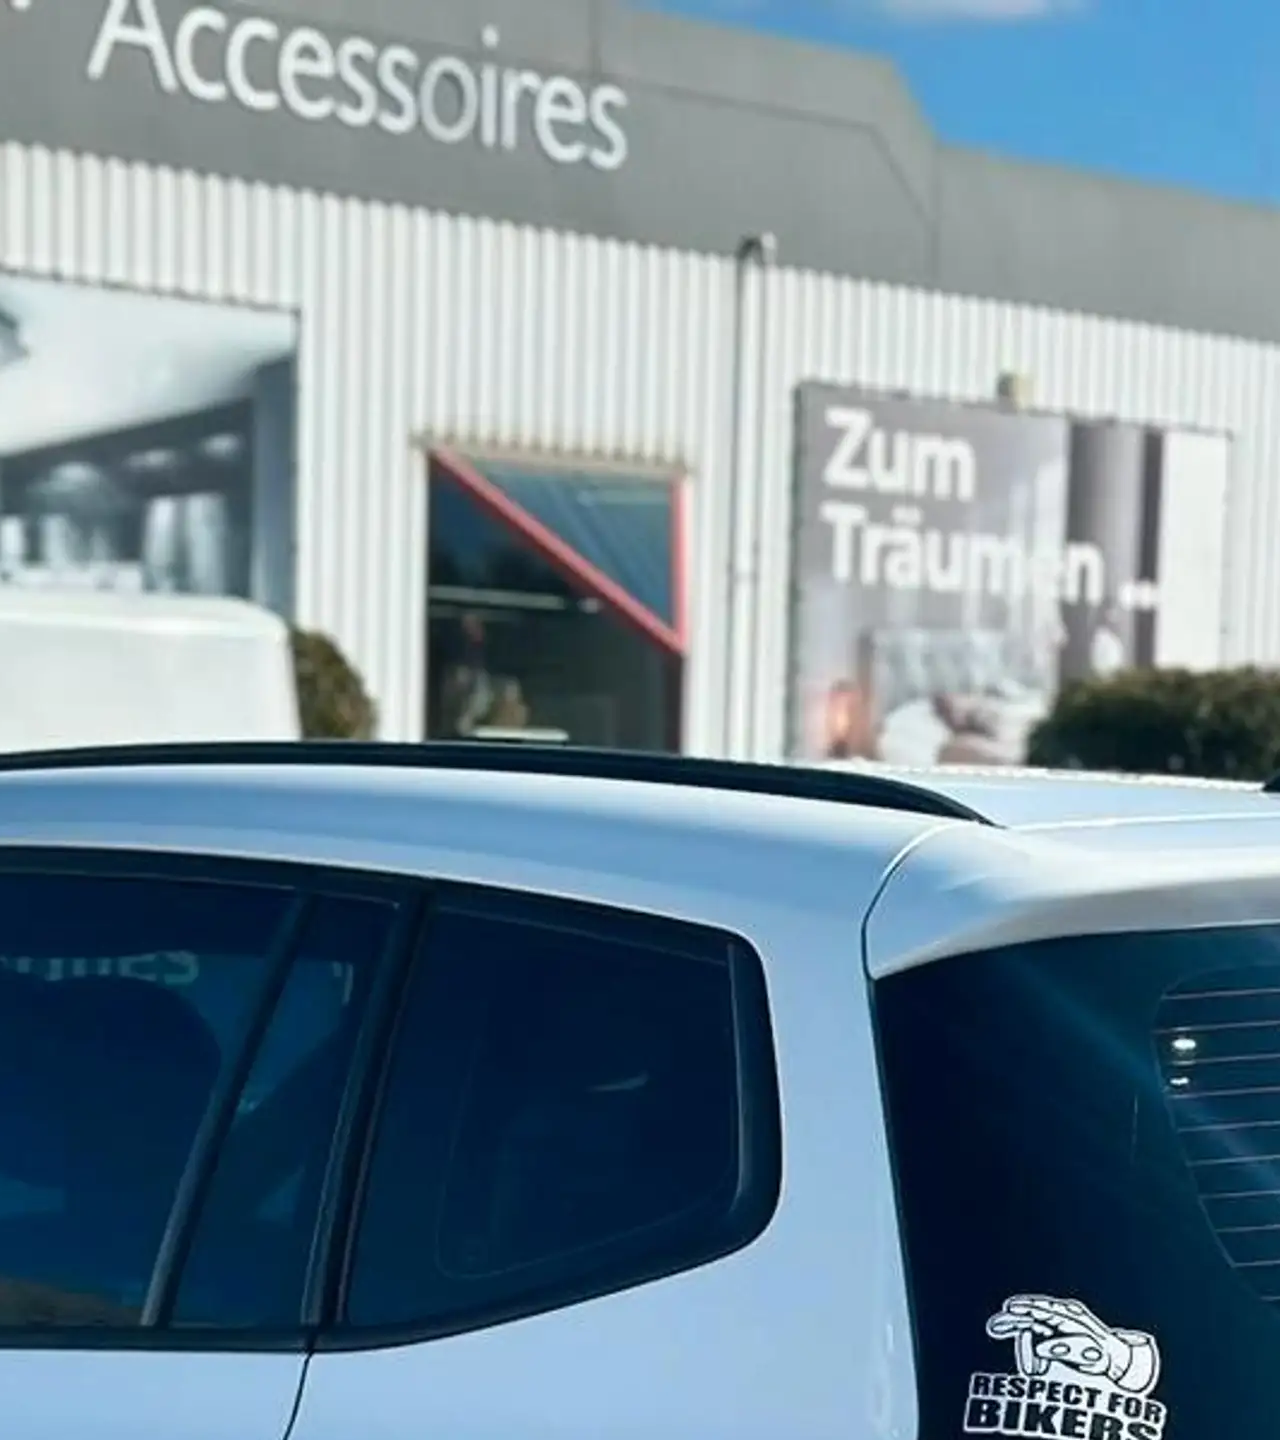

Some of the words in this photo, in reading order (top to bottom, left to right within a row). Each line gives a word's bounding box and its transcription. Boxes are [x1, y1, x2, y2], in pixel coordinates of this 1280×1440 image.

[87, 0, 629, 170] Accessoires
[823, 406, 976, 500] Zum
[972, 1374, 1103, 1409] RESPECT
[1108, 1392, 1163, 1425] FOR
